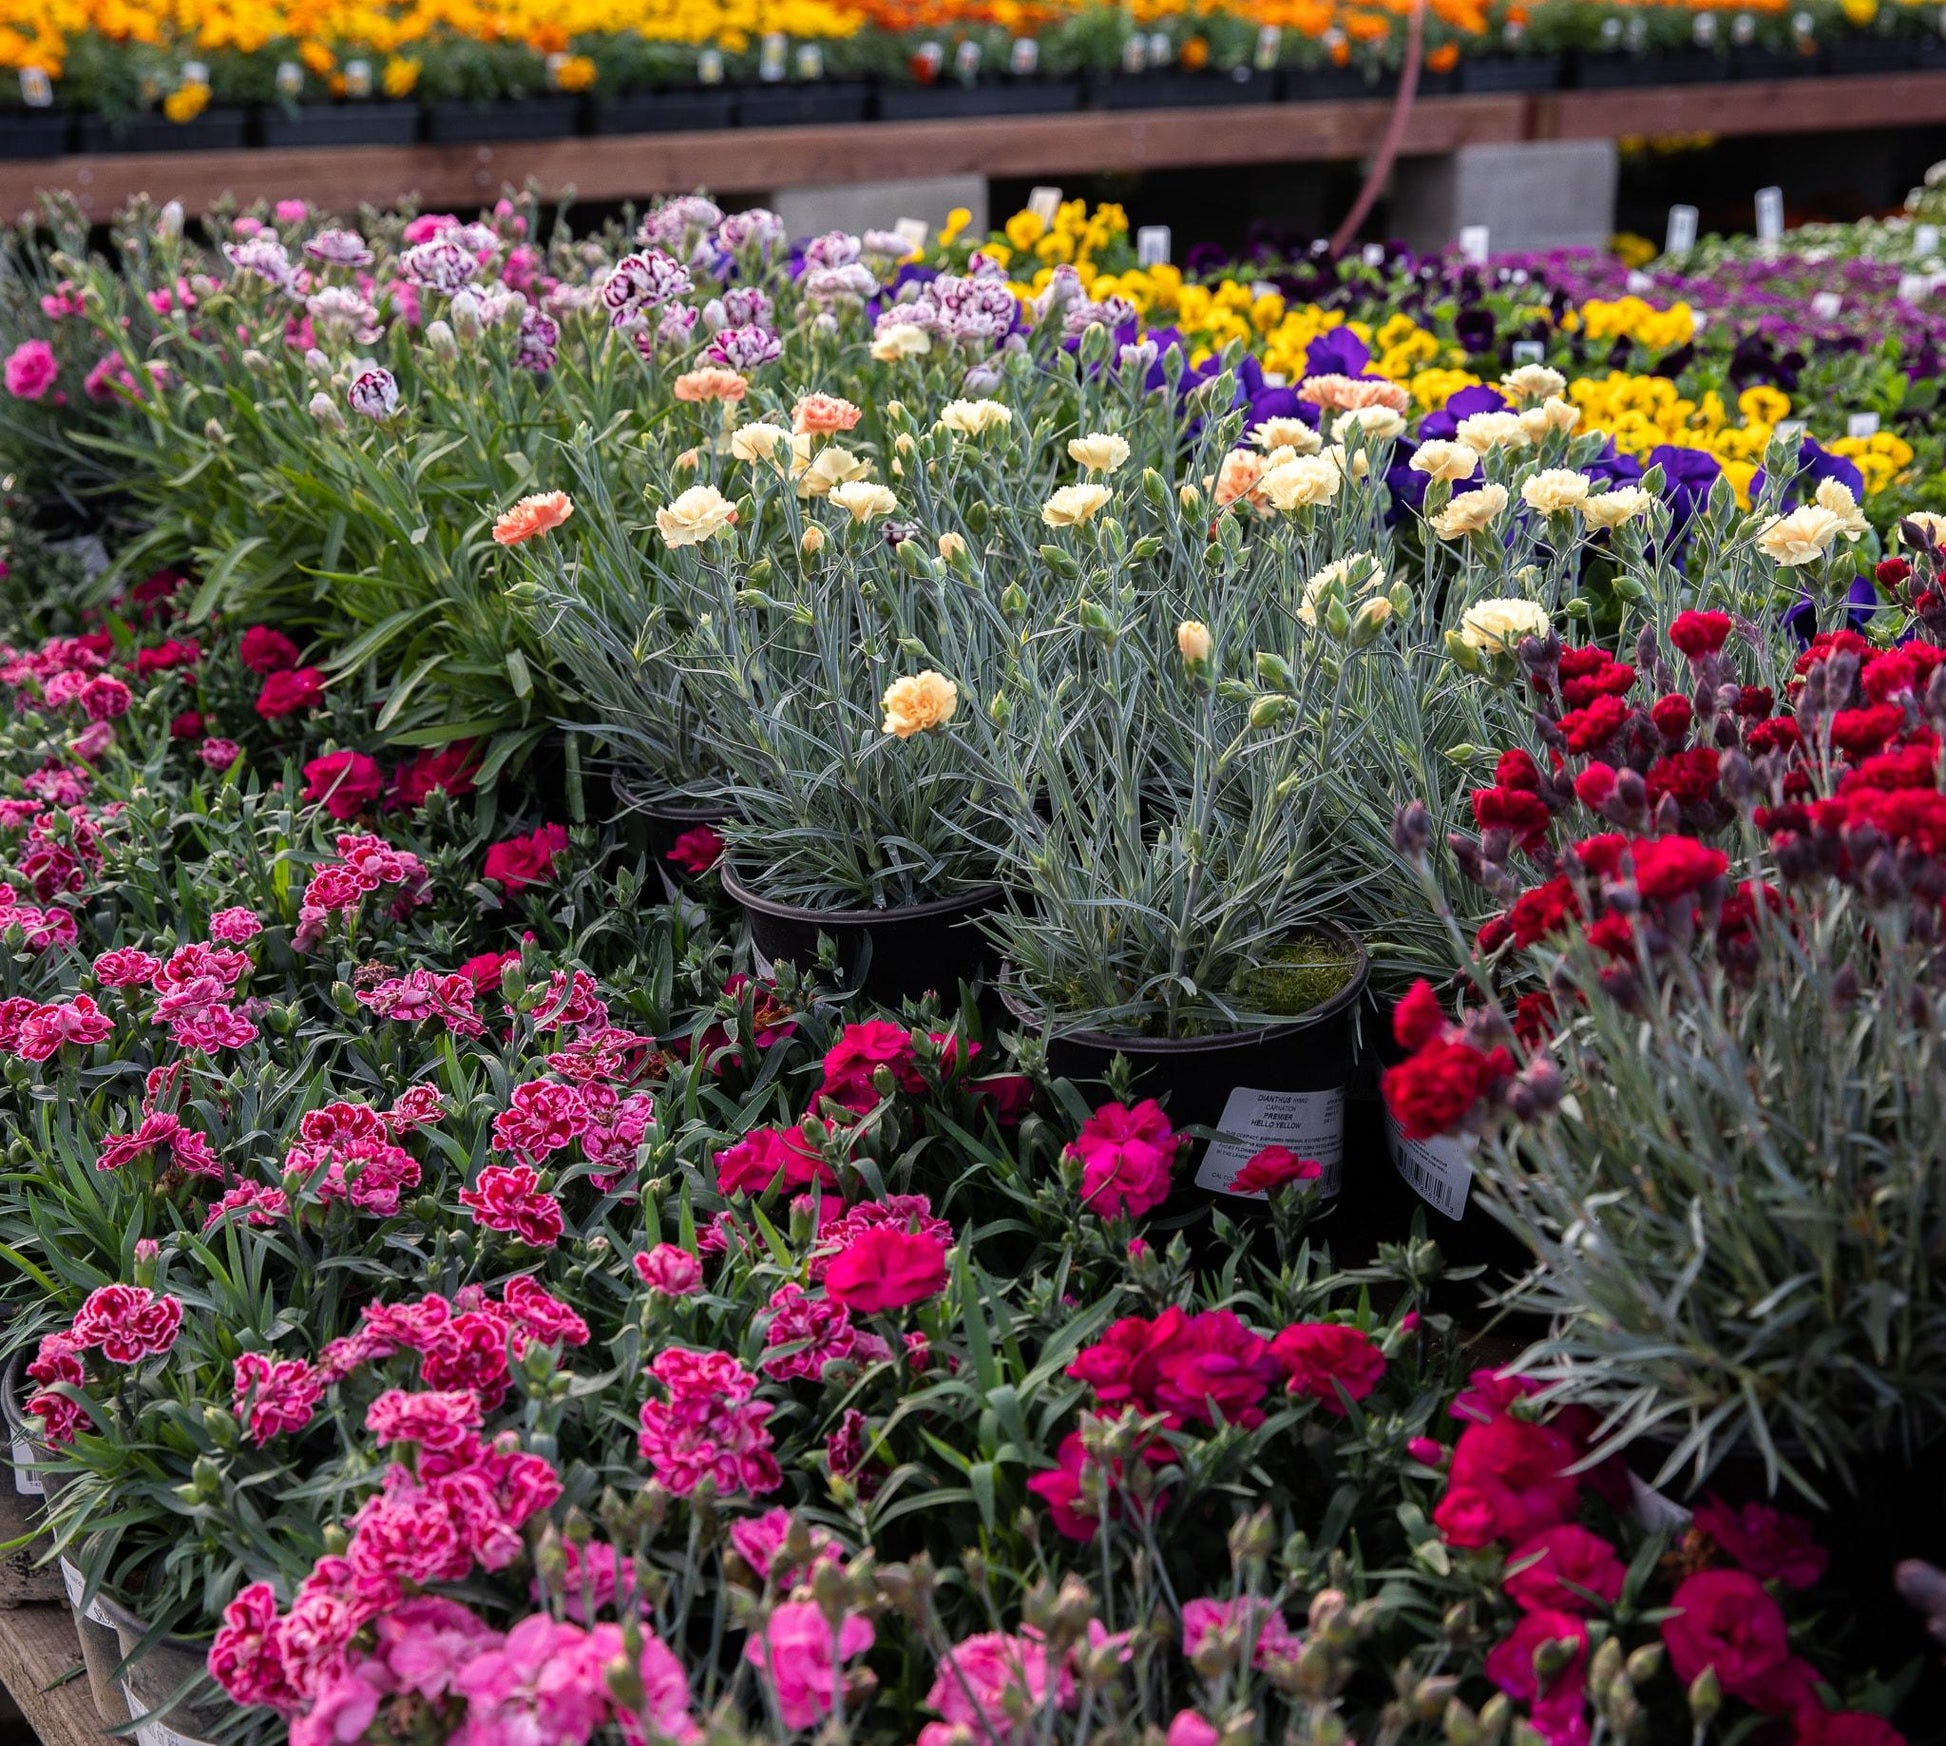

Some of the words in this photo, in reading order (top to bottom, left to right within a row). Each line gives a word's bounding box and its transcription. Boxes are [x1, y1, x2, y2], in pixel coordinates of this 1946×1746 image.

[1257, 1094, 1291, 1104] DIANTHUS
[1263, 1112, 1293, 1120] PREMIER
[1250, 1119, 1274, 1128] HELLO
[1275, 1121, 1302, 1129] YELLOW
